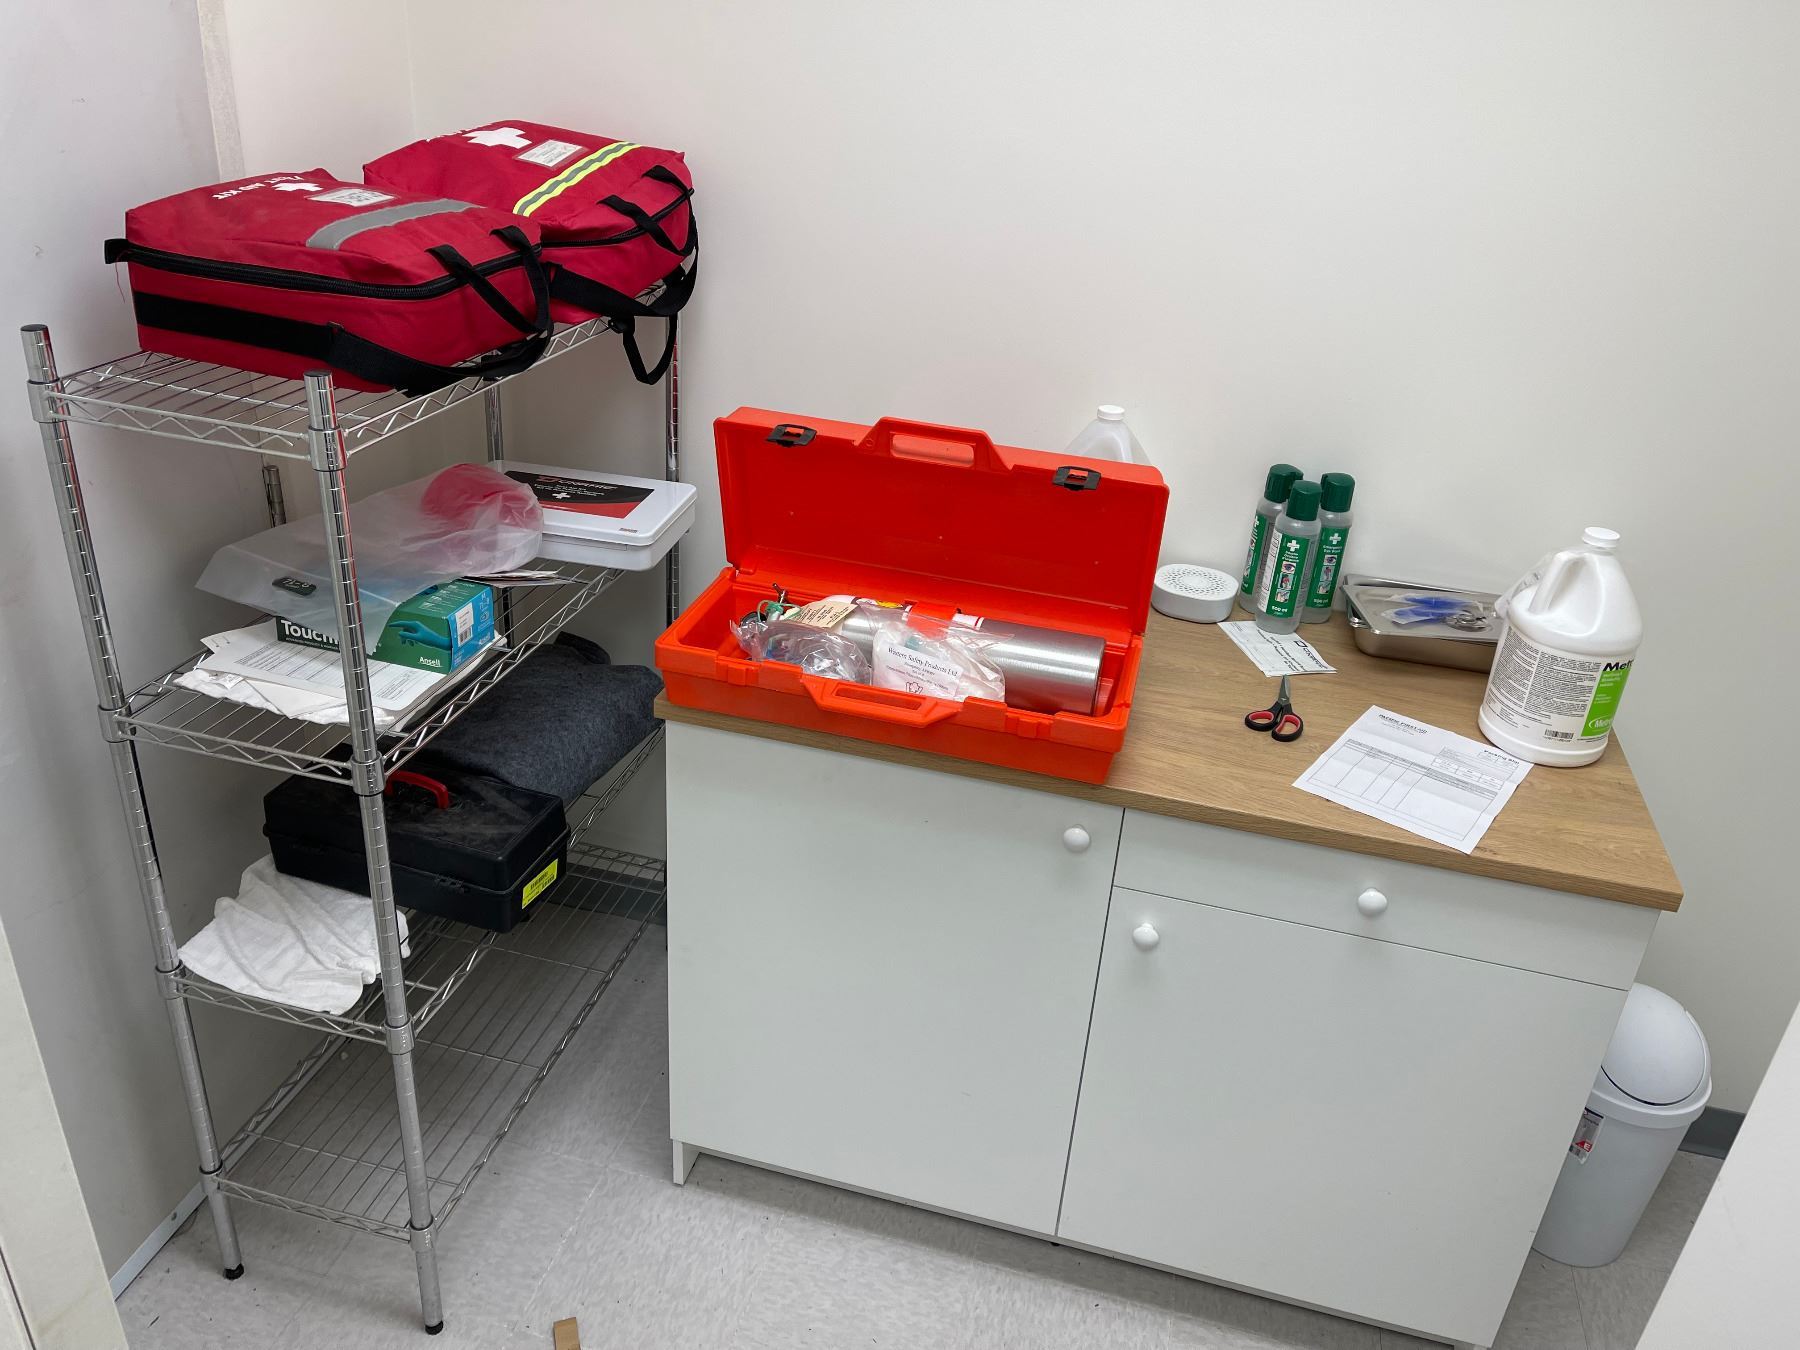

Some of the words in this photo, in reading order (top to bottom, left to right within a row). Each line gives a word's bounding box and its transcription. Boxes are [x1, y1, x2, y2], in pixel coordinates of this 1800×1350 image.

[420, 656, 442, 668] Ansell
[888, 647, 907, 660] Western
[908, 654, 923, 665] Safety
